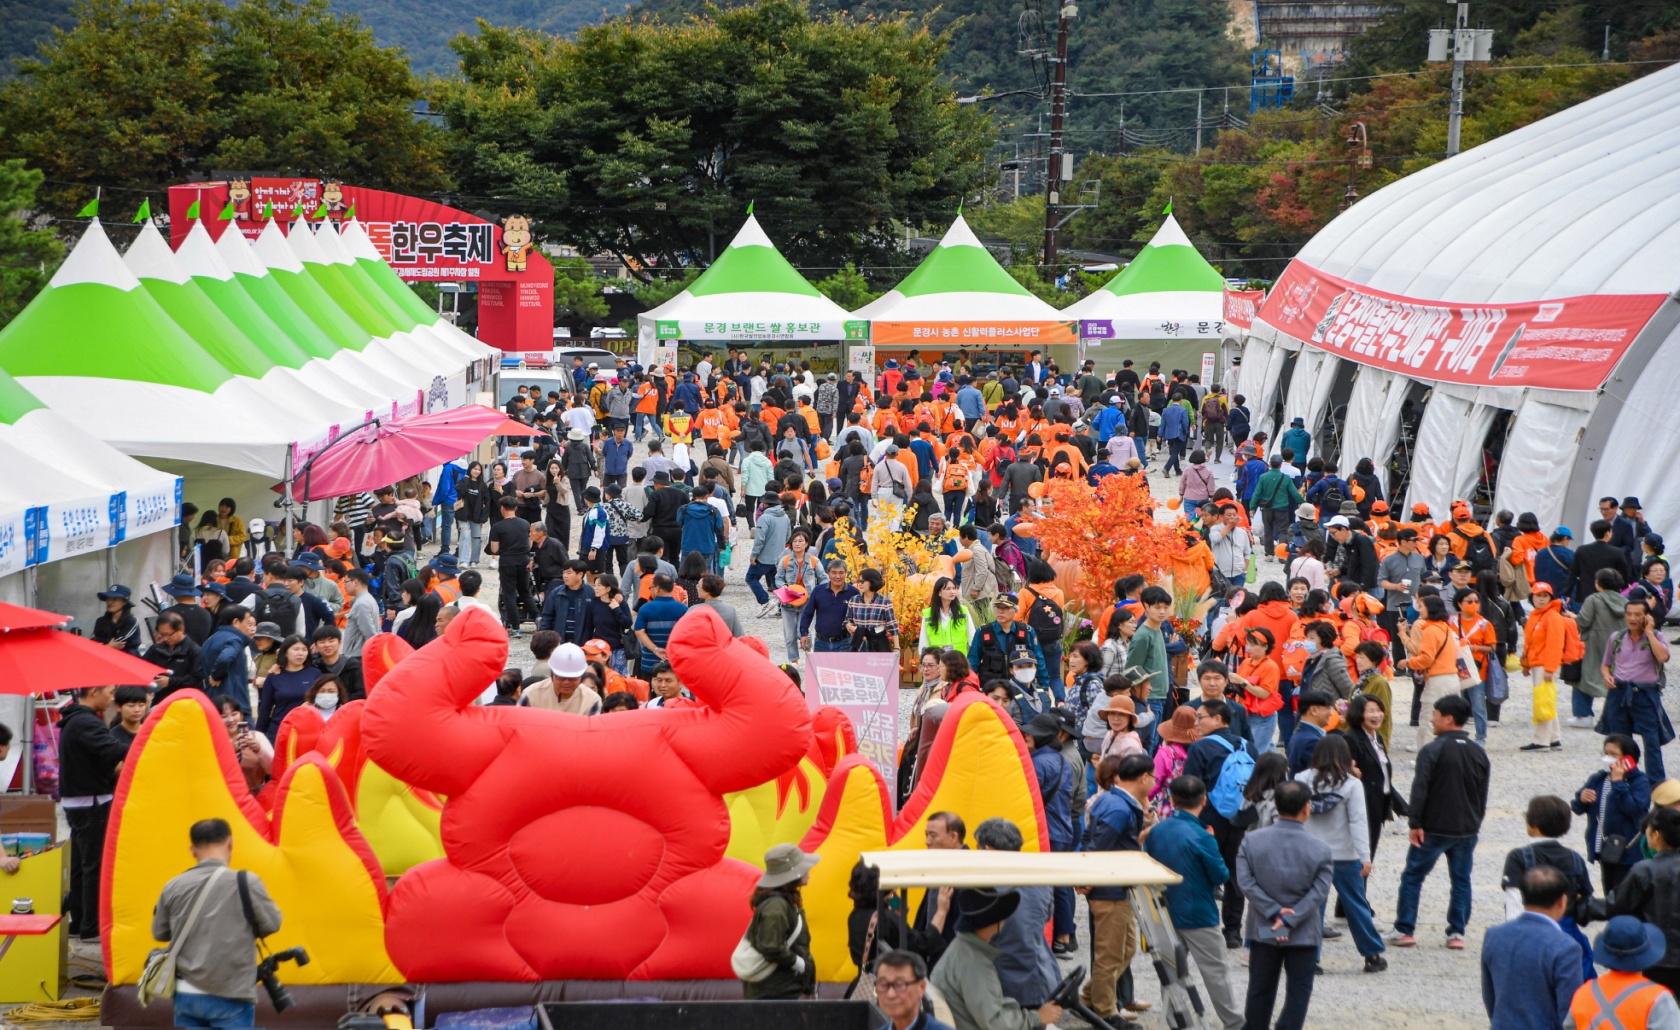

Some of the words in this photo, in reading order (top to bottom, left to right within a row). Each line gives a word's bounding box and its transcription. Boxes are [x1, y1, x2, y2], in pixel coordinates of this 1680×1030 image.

[704, 322, 727, 333] 문경
[731, 322, 766, 333] 브랜드
[770, 322, 781, 333] 쌀
[786, 322, 821, 333] 홍보관
[913, 327, 939, 337] 문경시
[942, 327, 959, 337] 농촌
[963, 327, 1040, 337] 신활력플러스사업단
